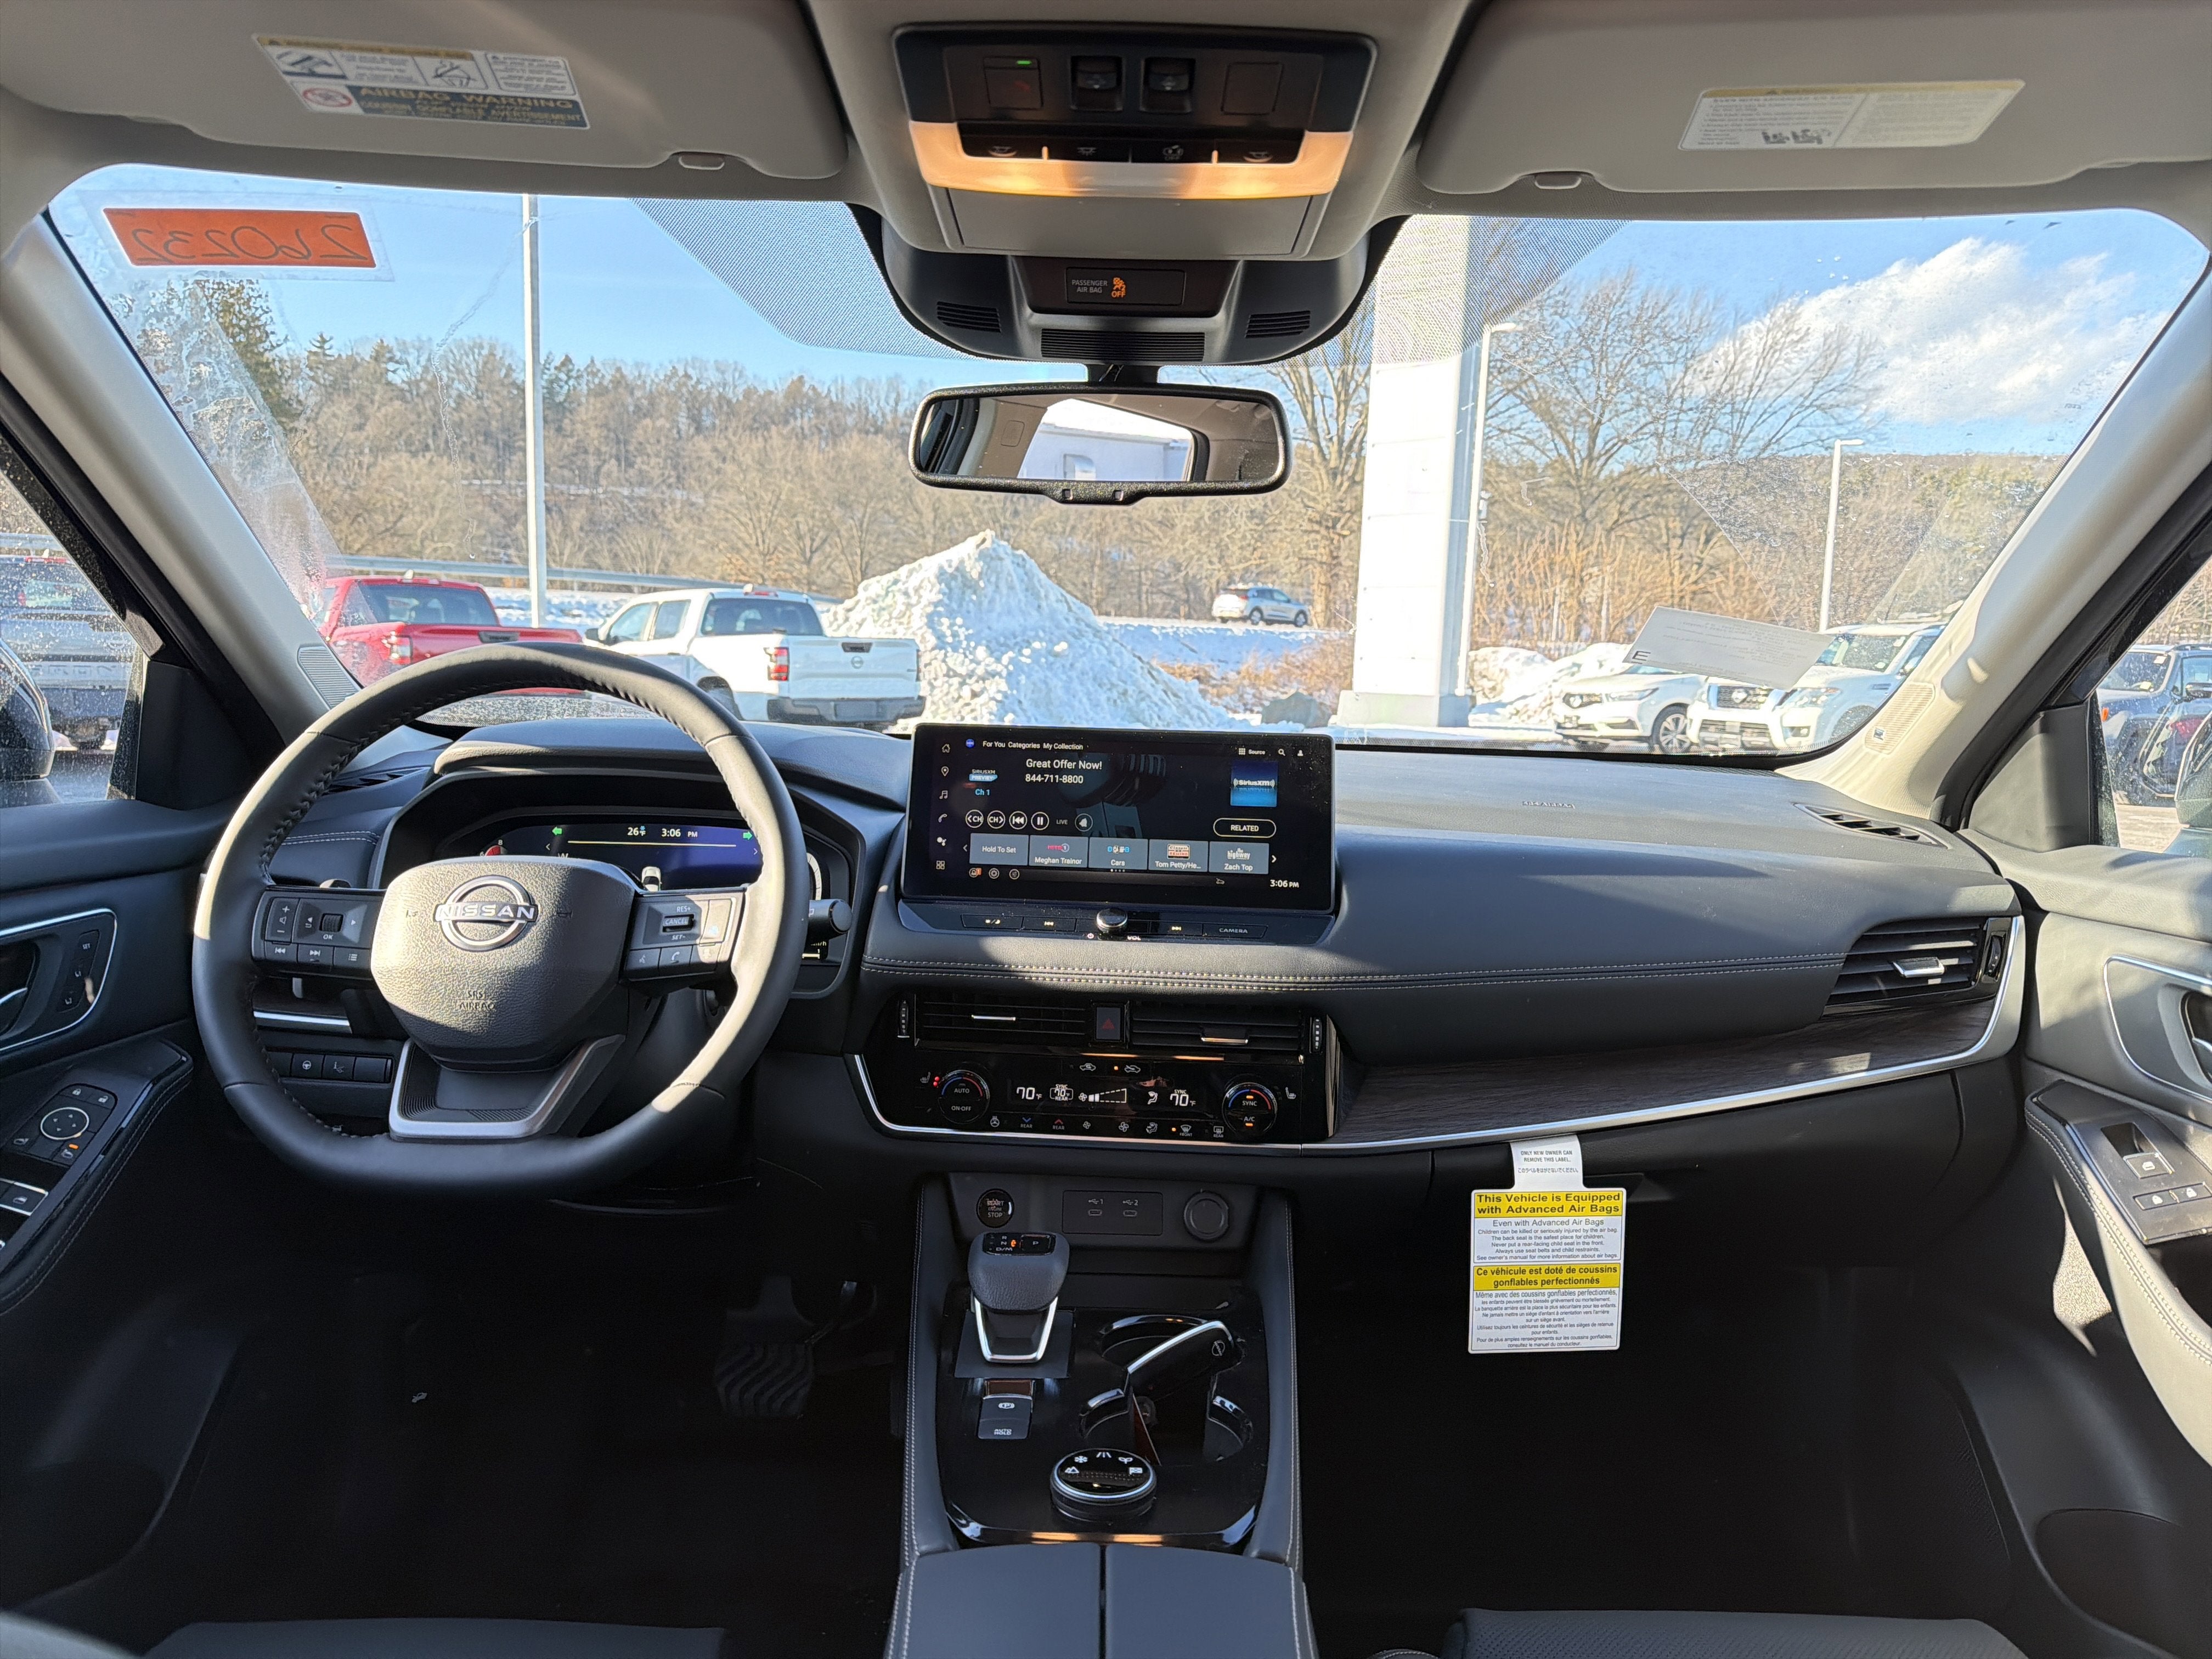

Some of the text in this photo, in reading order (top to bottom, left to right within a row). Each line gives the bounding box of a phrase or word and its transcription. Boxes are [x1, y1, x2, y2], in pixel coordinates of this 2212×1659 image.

[1008, 742, 1040, 750] Categories
[1026, 759, 1102, 769] Great Offer Now!
[1025, 774, 1084, 783] 844-711-8800
[662, 828, 681, 837] 3:06
[1227, 850, 1250, 860] highway
[1035, 857, 1059, 865] Meghan
[1270, 879, 1288, 888] 3:06
[438, 904, 535, 919] NISSAN
[1477, 1193, 1620, 1204] This Vehicle is Equipped
[1477, 1204, 1620, 1214] with Advanced Air Bags
[1584, 1218, 1604, 1227] Bags
[1476, 1268, 1488, 1276] Ce
[1491, 1267, 1526, 1276] véhicule
[1544, 1266, 1563, 1274] doté
[1566, 1266, 1576, 1274] de
[1578, 1266, 1617, 1274] coussins
[1493, 1276, 1600, 1288] gonflables perfectionnés
[1547, 1290, 1576, 1298] gonflables
[1577, 1289, 1617, 1297] perfectionnés,
